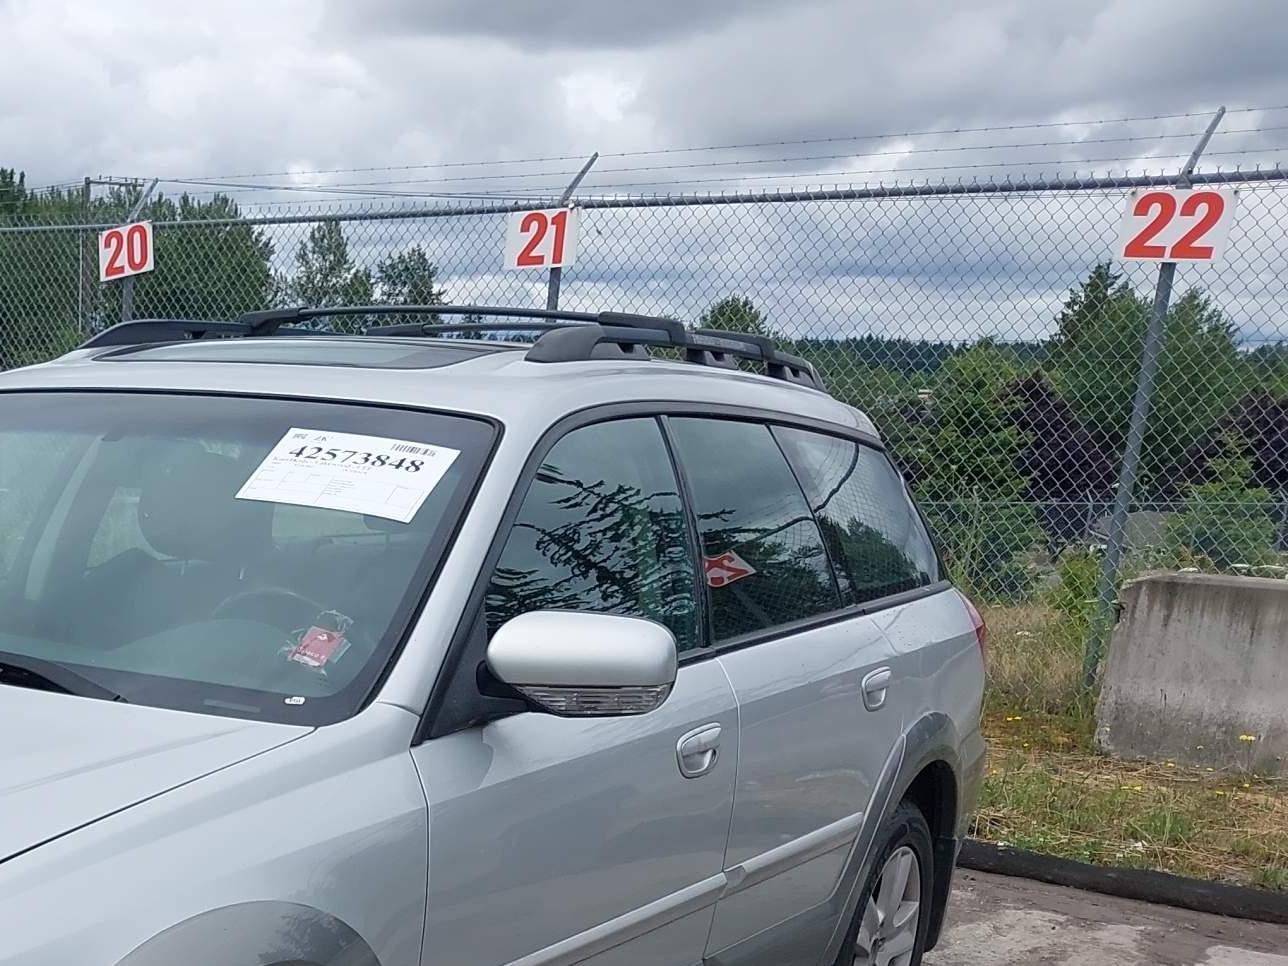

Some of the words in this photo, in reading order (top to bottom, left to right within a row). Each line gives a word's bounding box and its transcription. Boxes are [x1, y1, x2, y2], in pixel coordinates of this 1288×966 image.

[103, 224, 149, 277] 20
[516, 210, 567, 267] 21
[1123, 191, 1225, 259] 22
[289, 445, 425, 473] 42573848
